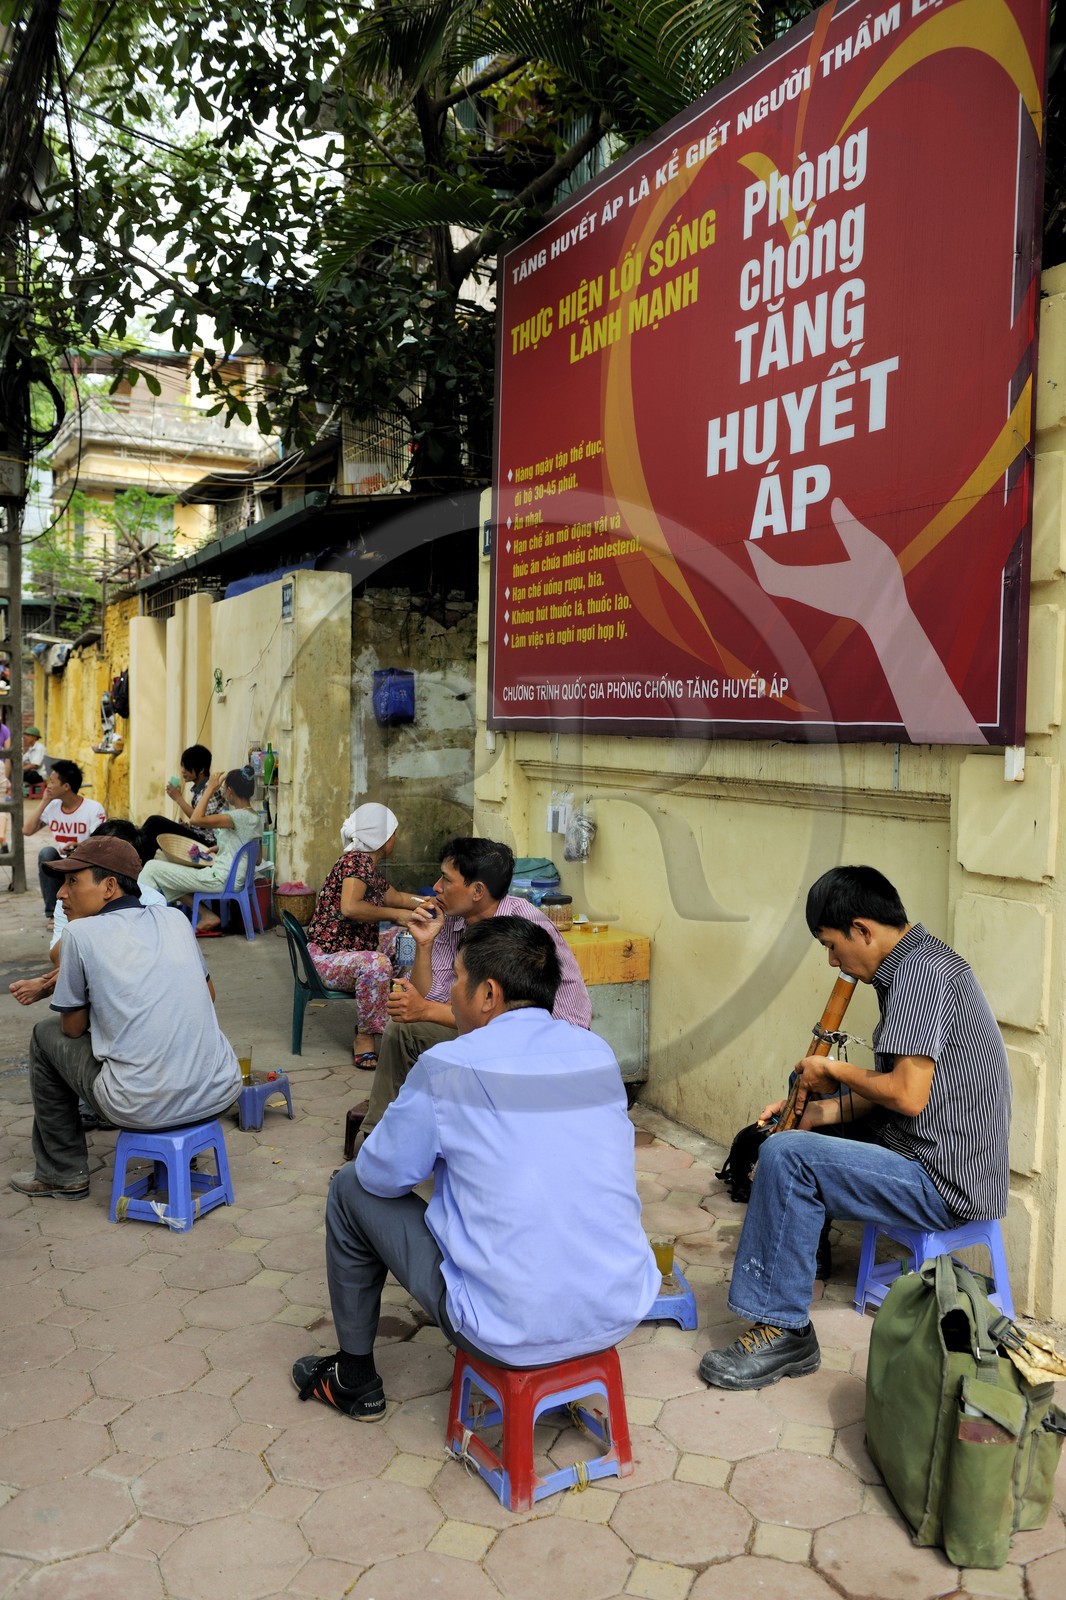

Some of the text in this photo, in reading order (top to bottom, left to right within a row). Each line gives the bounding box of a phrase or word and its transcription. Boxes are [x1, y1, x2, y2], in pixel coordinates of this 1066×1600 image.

[512, 249, 547, 285] TĂNG
[550, 211, 598, 260] HUYẾT
[601, 195, 623, 226] ÁP
[628, 175, 650, 208] LÀ
[655, 148, 679, 190] KẺ
[685, 119, 731, 169] GIẾT
[737, 64, 811, 135] NGƯỜI
[743, 126, 868, 241] Phòng
[739, 202, 865, 312] chống
[511, 208, 716, 355] THỰC HIỆN LỐI SỐNG
[569, 267, 699, 365] LÀNH MẠNH
[734, 277, 866, 385] TĂNG
[706, 341, 899, 478] HUYẾT
[515, 465, 534, 484] Hàng
[535, 456, 553, 476] ngày
[555, 451, 568, 471] tập
[570, 439, 585, 464] thể
[523, 487, 533, 506] bộ
[534, 479, 557, 500] 30-45
[748, 459, 831, 540] ÁP
[513, 513, 523, 531] Ăn
[513, 539, 527, 557] Hạn
[529, 530, 544, 550] chế
[544, 531, 555, 546] ăn
[571, 522, 592, 542] động
[594, 516, 608, 536] vật
[609, 512, 621, 530] và
[512, 560, 529, 579] thức
[530, 560, 540, 575] ăn
[562, 545, 586, 568] nhiều
[511, 608, 534, 625] Không
[536, 605, 548, 622] hút
[550, 599, 572, 620] thuốc
[587, 593, 612, 615] thuốc
[512, 586, 526, 603] Hạn
[527, 579, 543, 598] chế
[543, 577, 563, 596] uống
[511, 633, 526, 649] Làm
[528, 631, 544, 649] việc
[545, 629, 555, 645] và
[576, 623, 596, 643] ngơi
[597, 621, 614, 643] hợp
[502, 684, 535, 701] CHƯƠNG
[536, 680, 560, 700] TRÌNH
[561, 676, 587, 700] QUỐC
[588, 682, 605, 699] GIA
[607, 676, 642, 699] PHÒNG
[644, 672, 683, 699] CHỐNG
[686, 675, 719, 698] TĂNG
[769, 671, 789, 698] ÁP
[49, 820, 87, 834] DAVID
